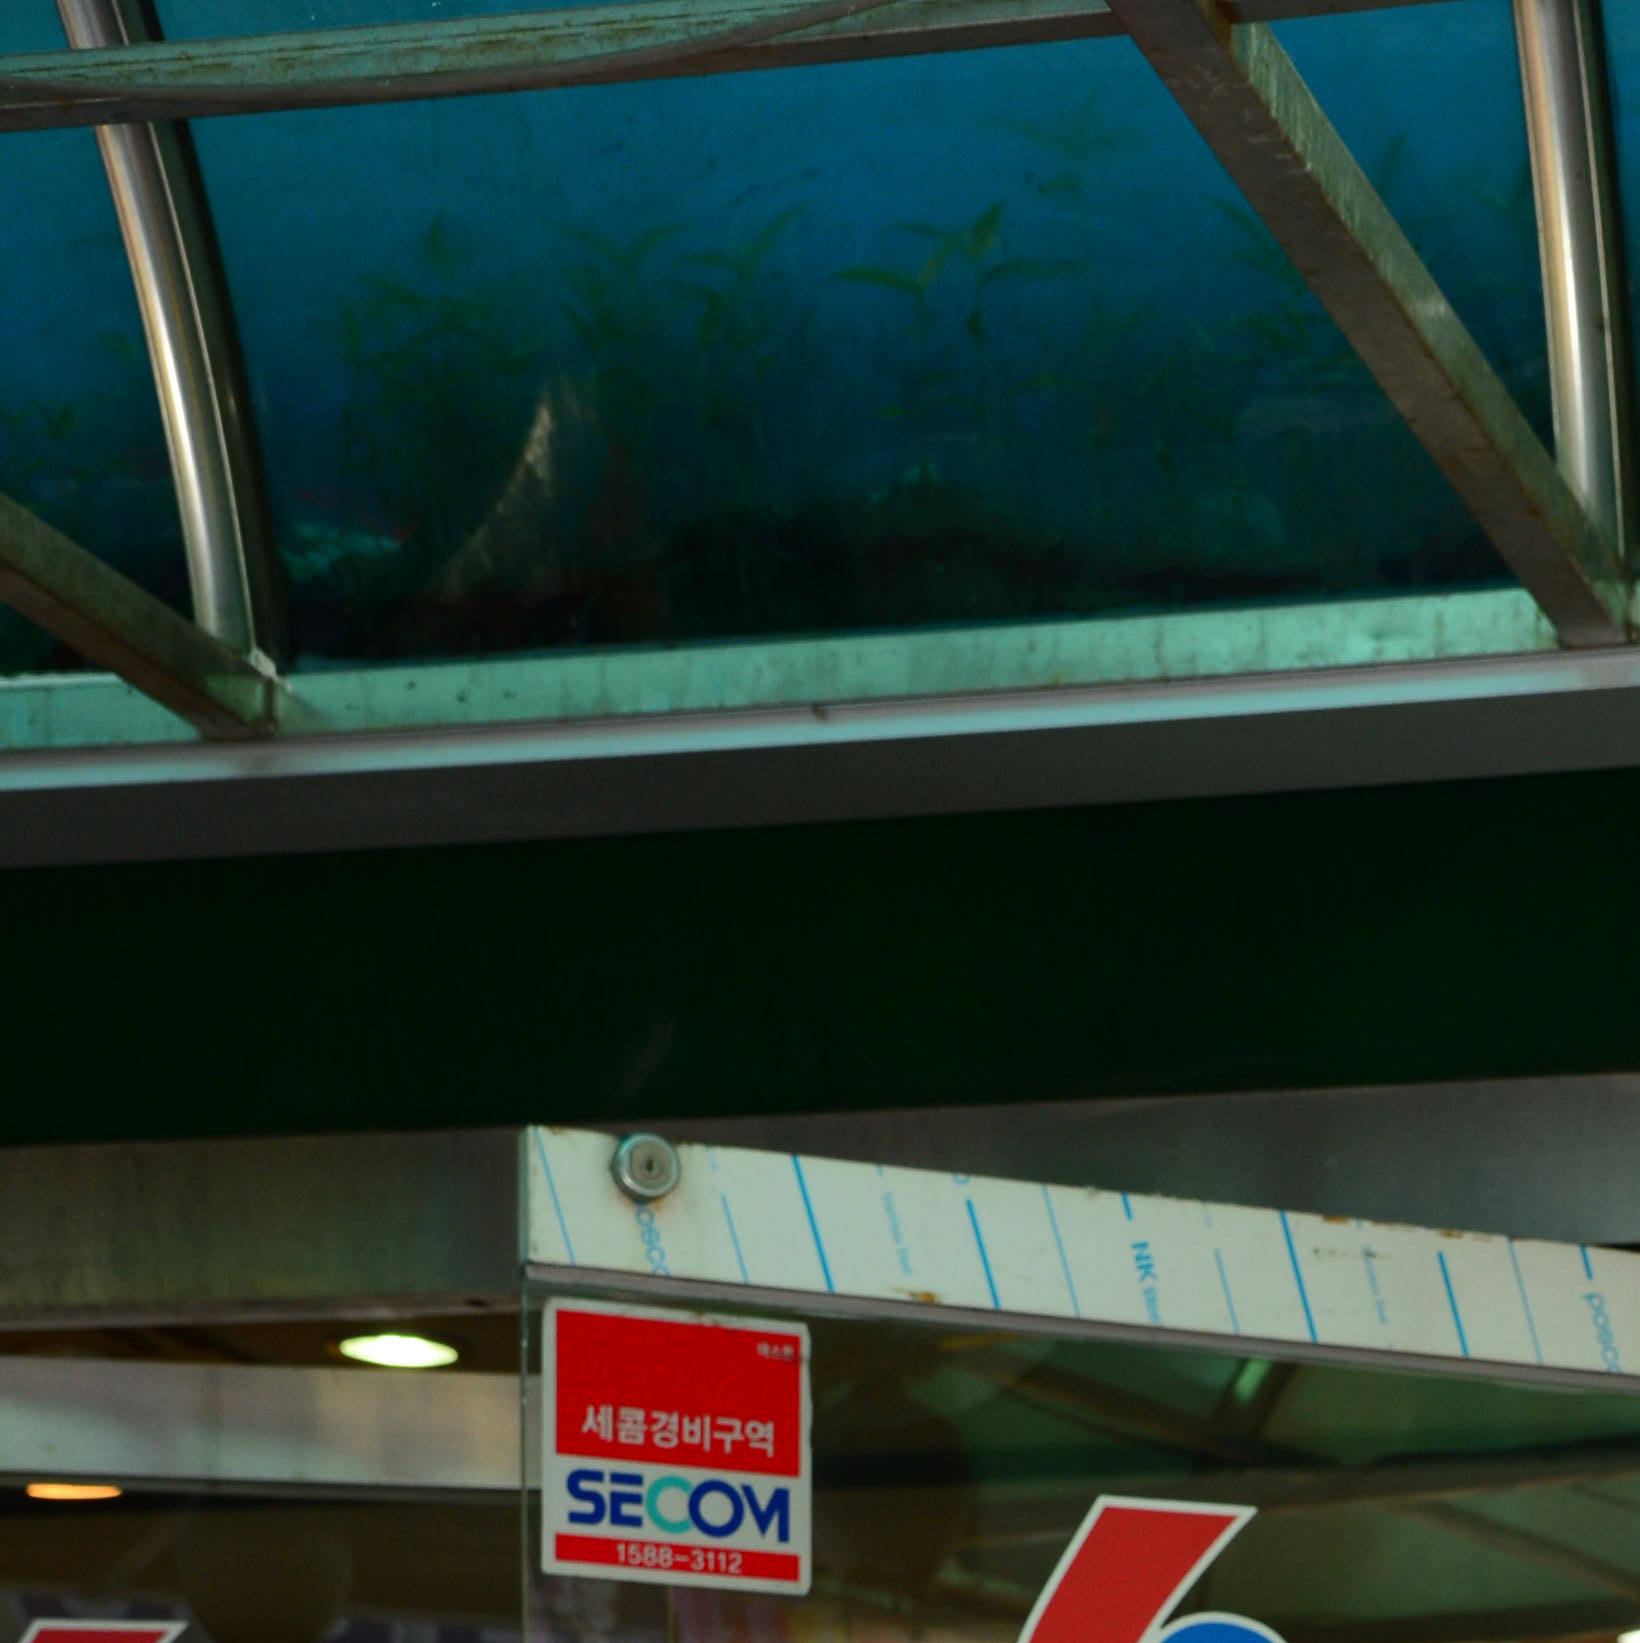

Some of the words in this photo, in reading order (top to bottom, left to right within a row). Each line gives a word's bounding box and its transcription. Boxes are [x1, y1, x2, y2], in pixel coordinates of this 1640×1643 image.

[581, 1404, 775, 1458] 세콤경비구역
[566, 1468, 790, 1543] SECOM
[615, 1542, 743, 1575] 1588-3112
